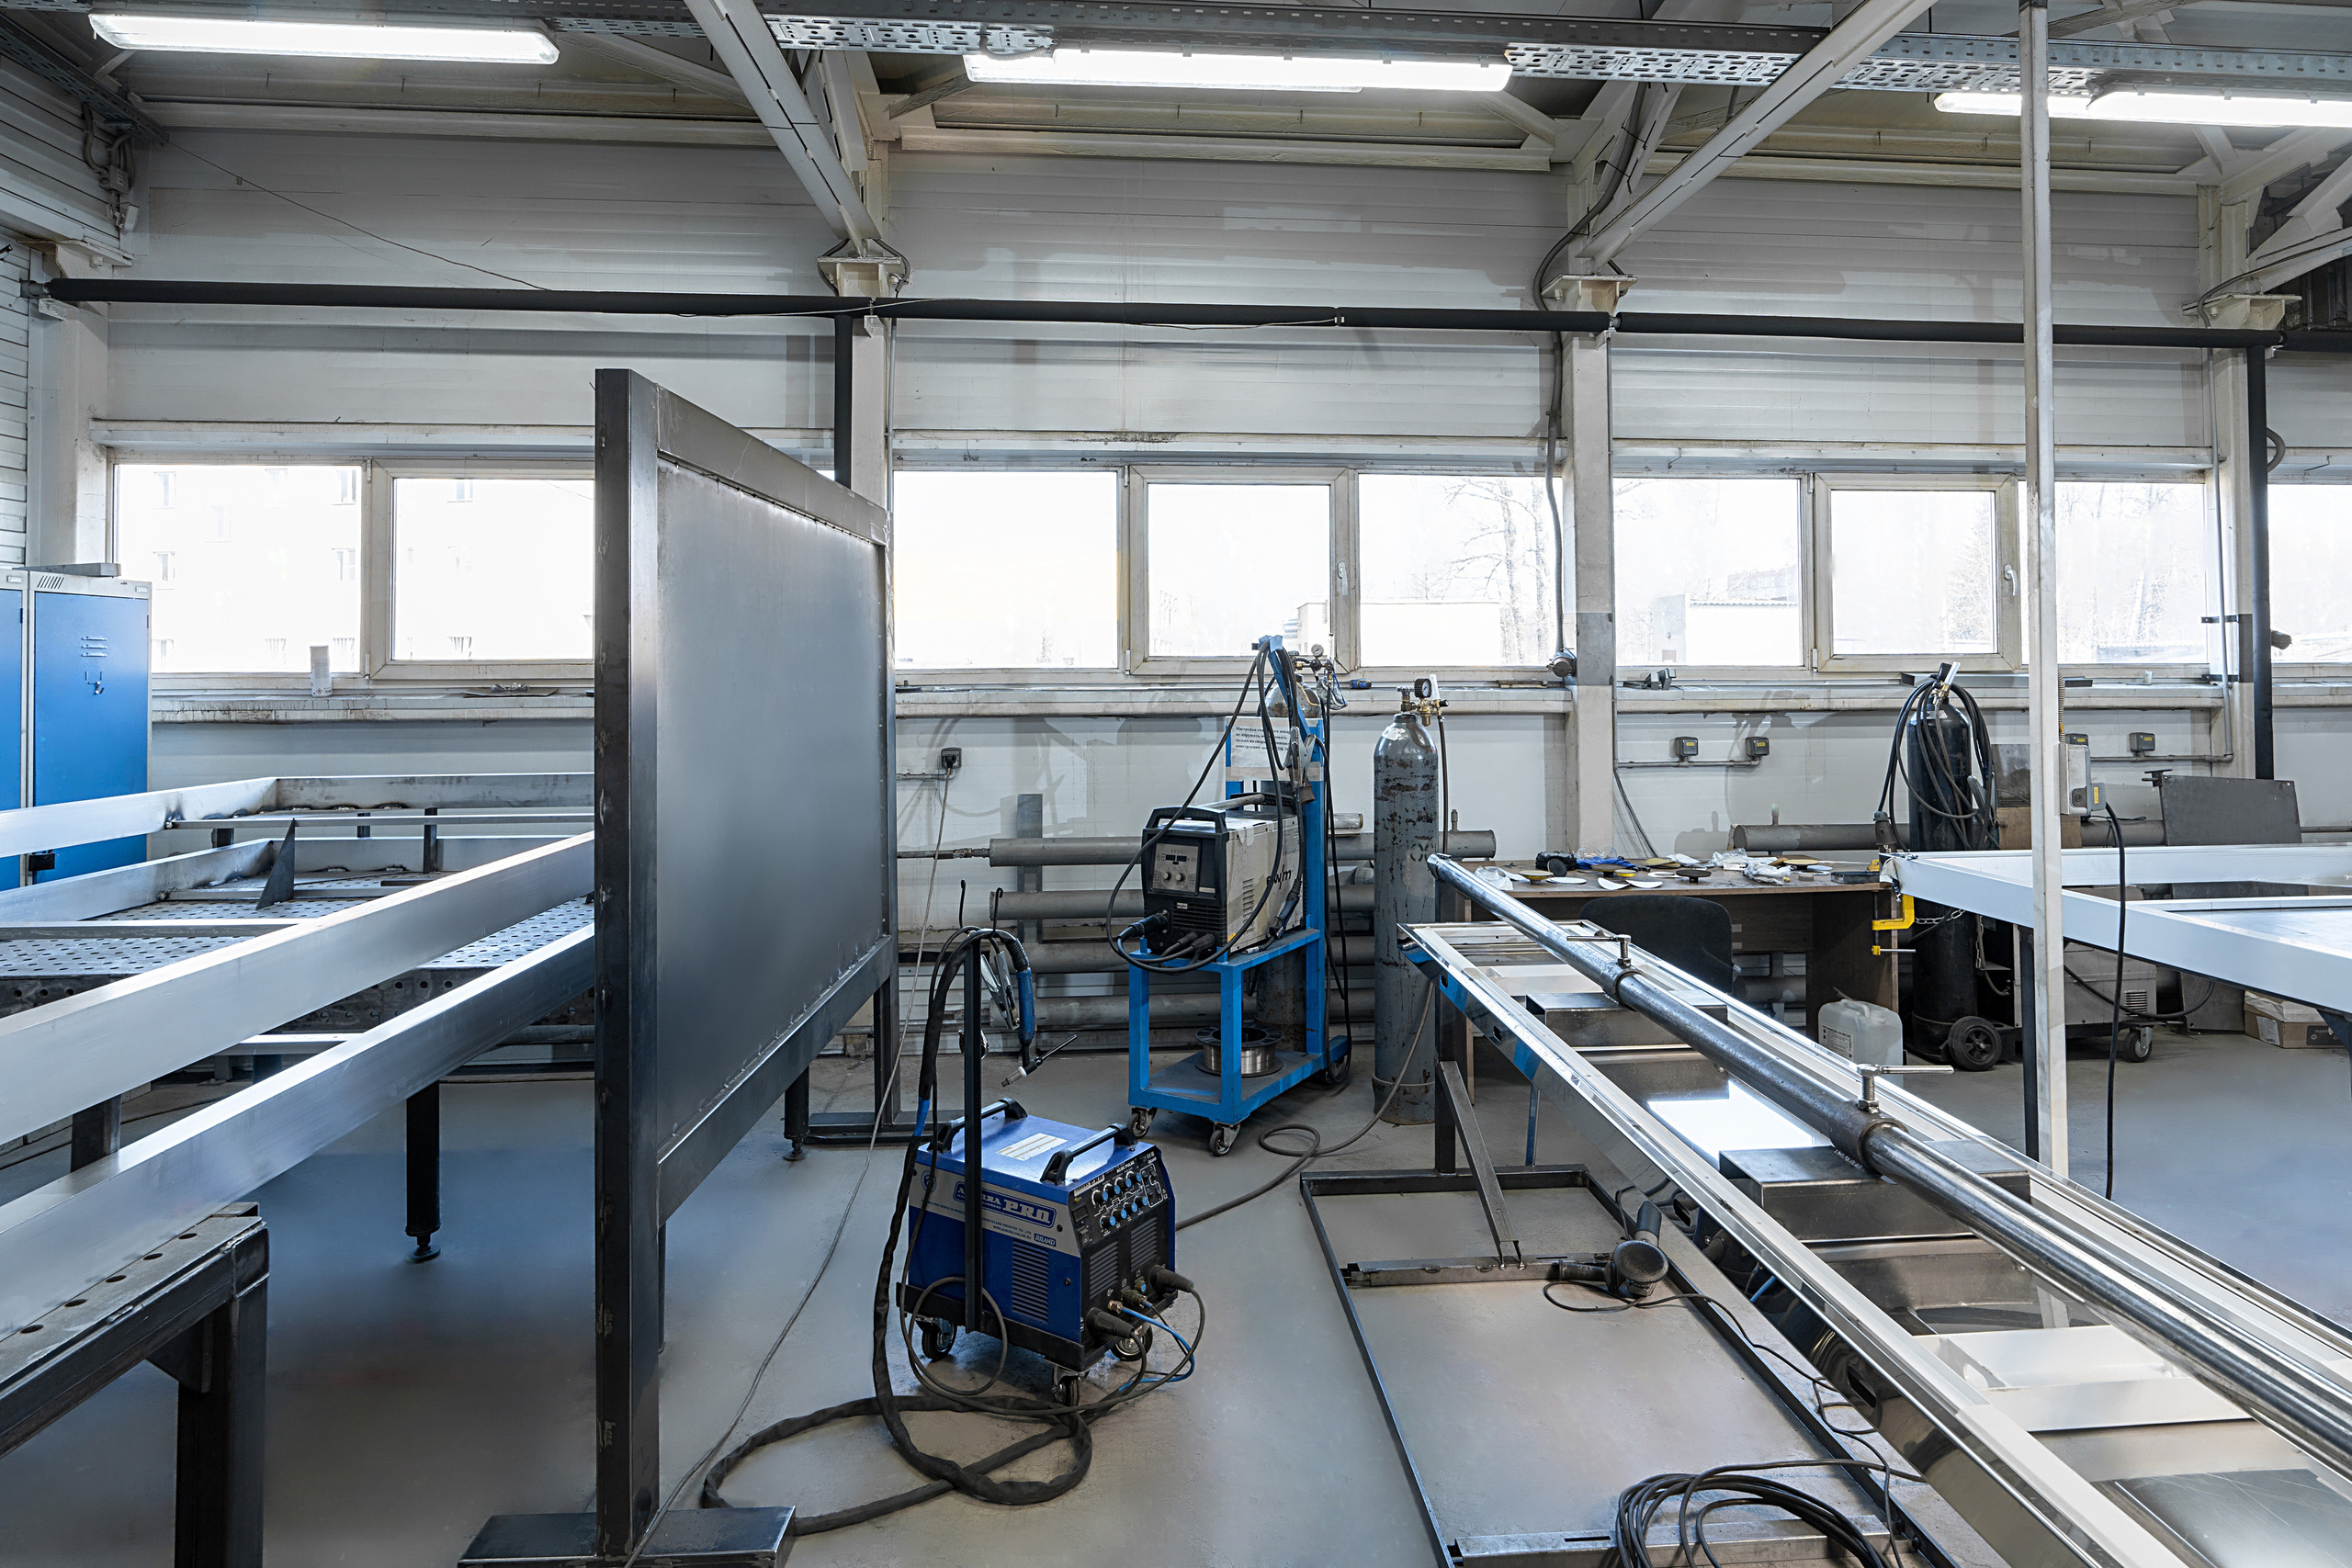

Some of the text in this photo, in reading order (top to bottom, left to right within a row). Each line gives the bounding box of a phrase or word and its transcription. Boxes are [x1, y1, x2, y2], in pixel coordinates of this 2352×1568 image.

[956, 1188, 1051, 1224] AORA PRO
[1035, 1235, 1056, 1246] RILAND
